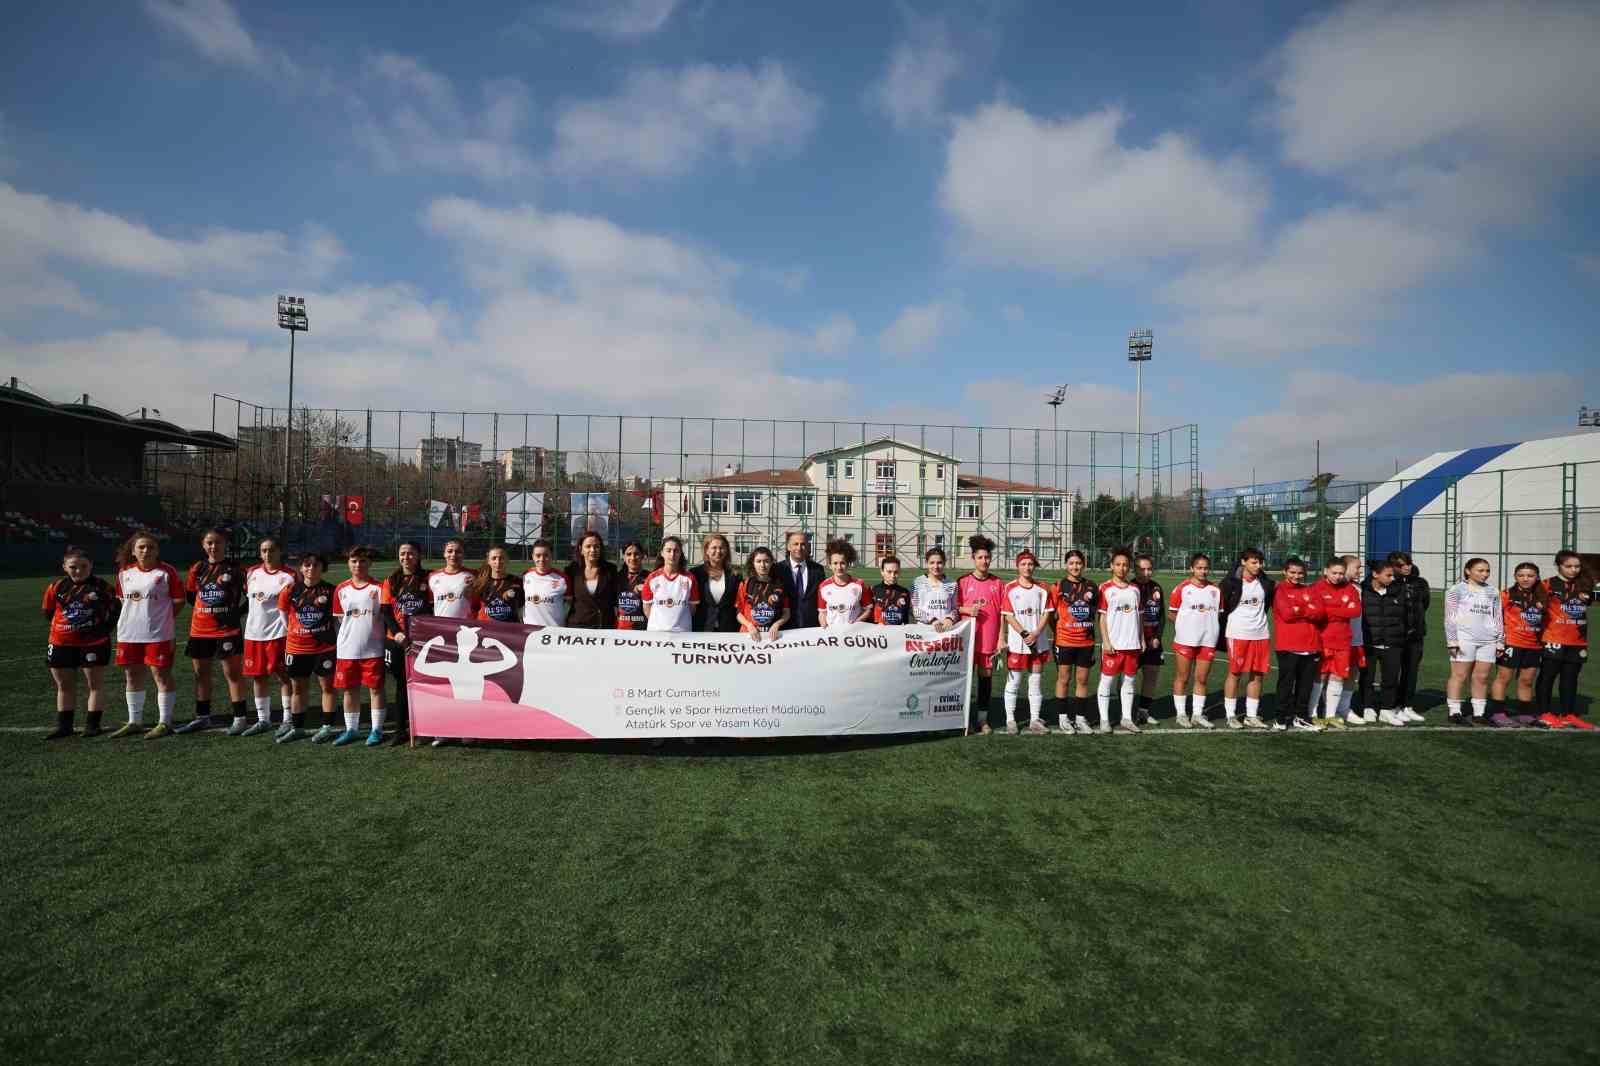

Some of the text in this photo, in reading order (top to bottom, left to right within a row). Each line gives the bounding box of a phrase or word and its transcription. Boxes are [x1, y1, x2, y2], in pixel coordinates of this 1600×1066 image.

[541, 634, 552, 645] 8
[557, 635, 606, 646] MART
[843, 634, 888, 649] GÜNÜ
[671, 653, 773, 665] TURNUVASI
[627, 689, 720, 698] 8 Mart Cumartesi
[625, 704, 826, 718] Gençlik ve Spor Hizmetleri Müdürlüğü
[625, 718, 667, 729] Atatürk
[670, 719, 694, 731] Spor
[699, 720, 712, 729] ve
[753, 718, 780, 730] Köyü
